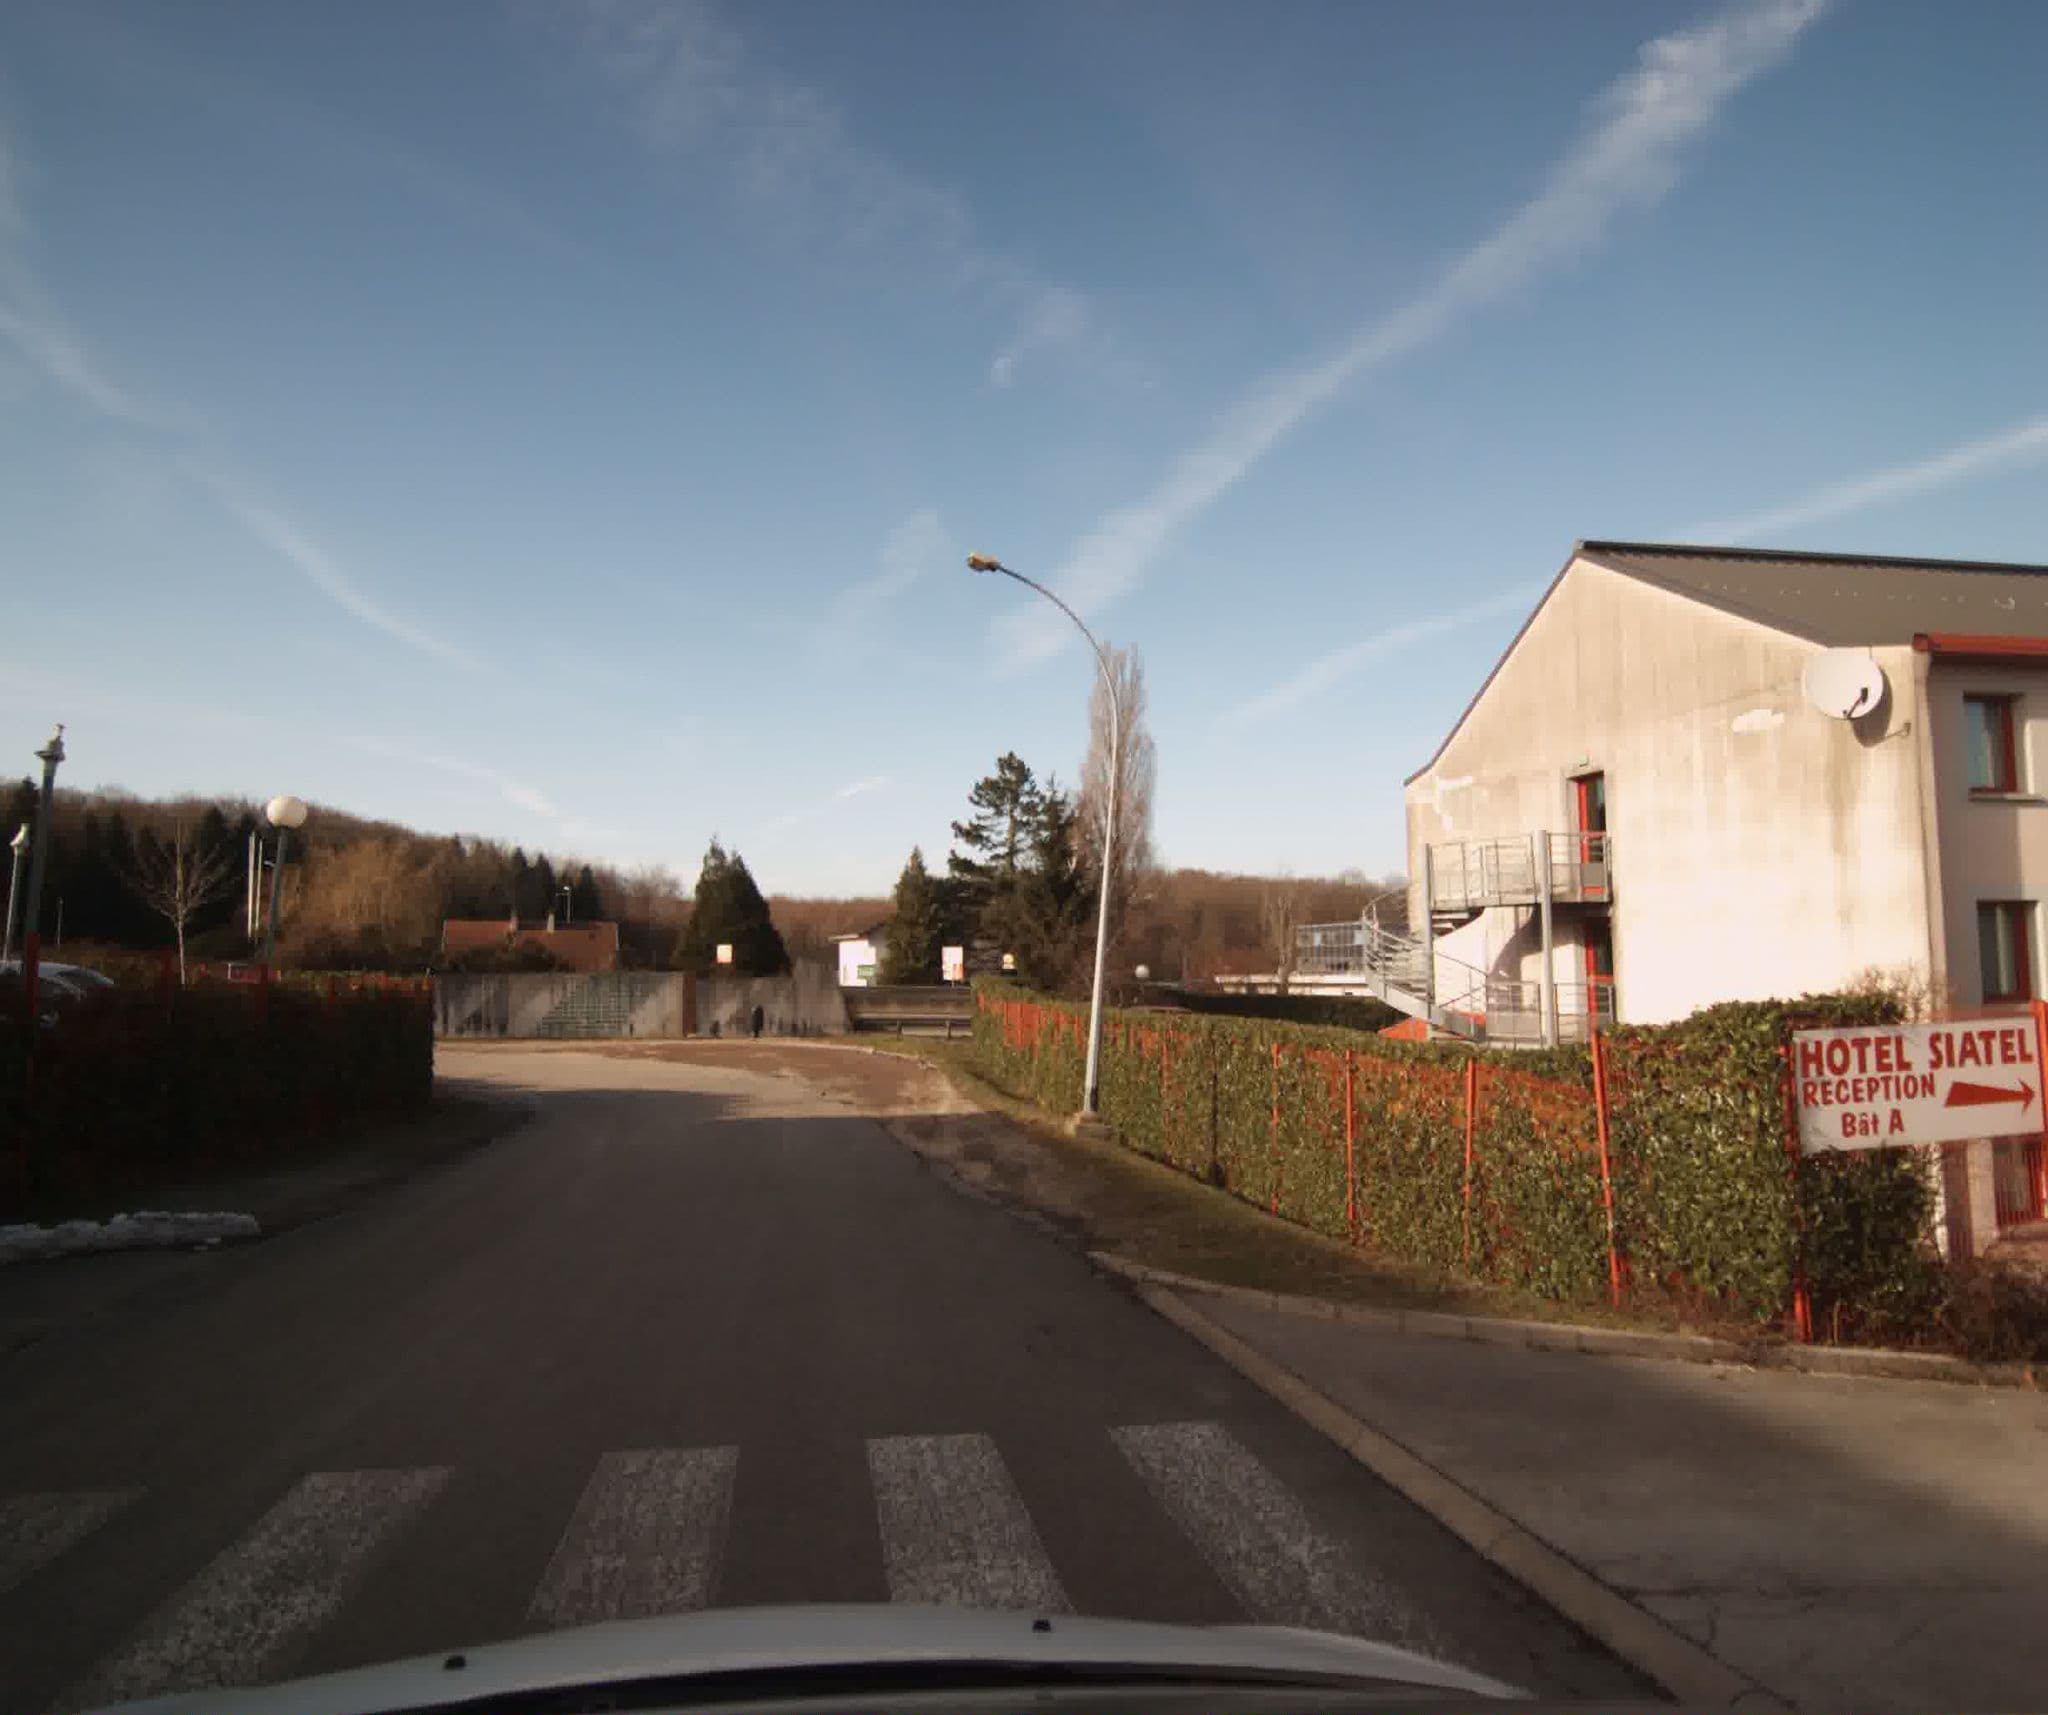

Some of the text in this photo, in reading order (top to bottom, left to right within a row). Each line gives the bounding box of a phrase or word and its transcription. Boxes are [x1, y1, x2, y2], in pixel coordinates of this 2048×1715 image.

[1800, 1028, 2033, 1077] HOTEL SIATEL
[1803, 1072, 1936, 1109] RECEPTION
[1889, 1109, 1904, 1135] A
